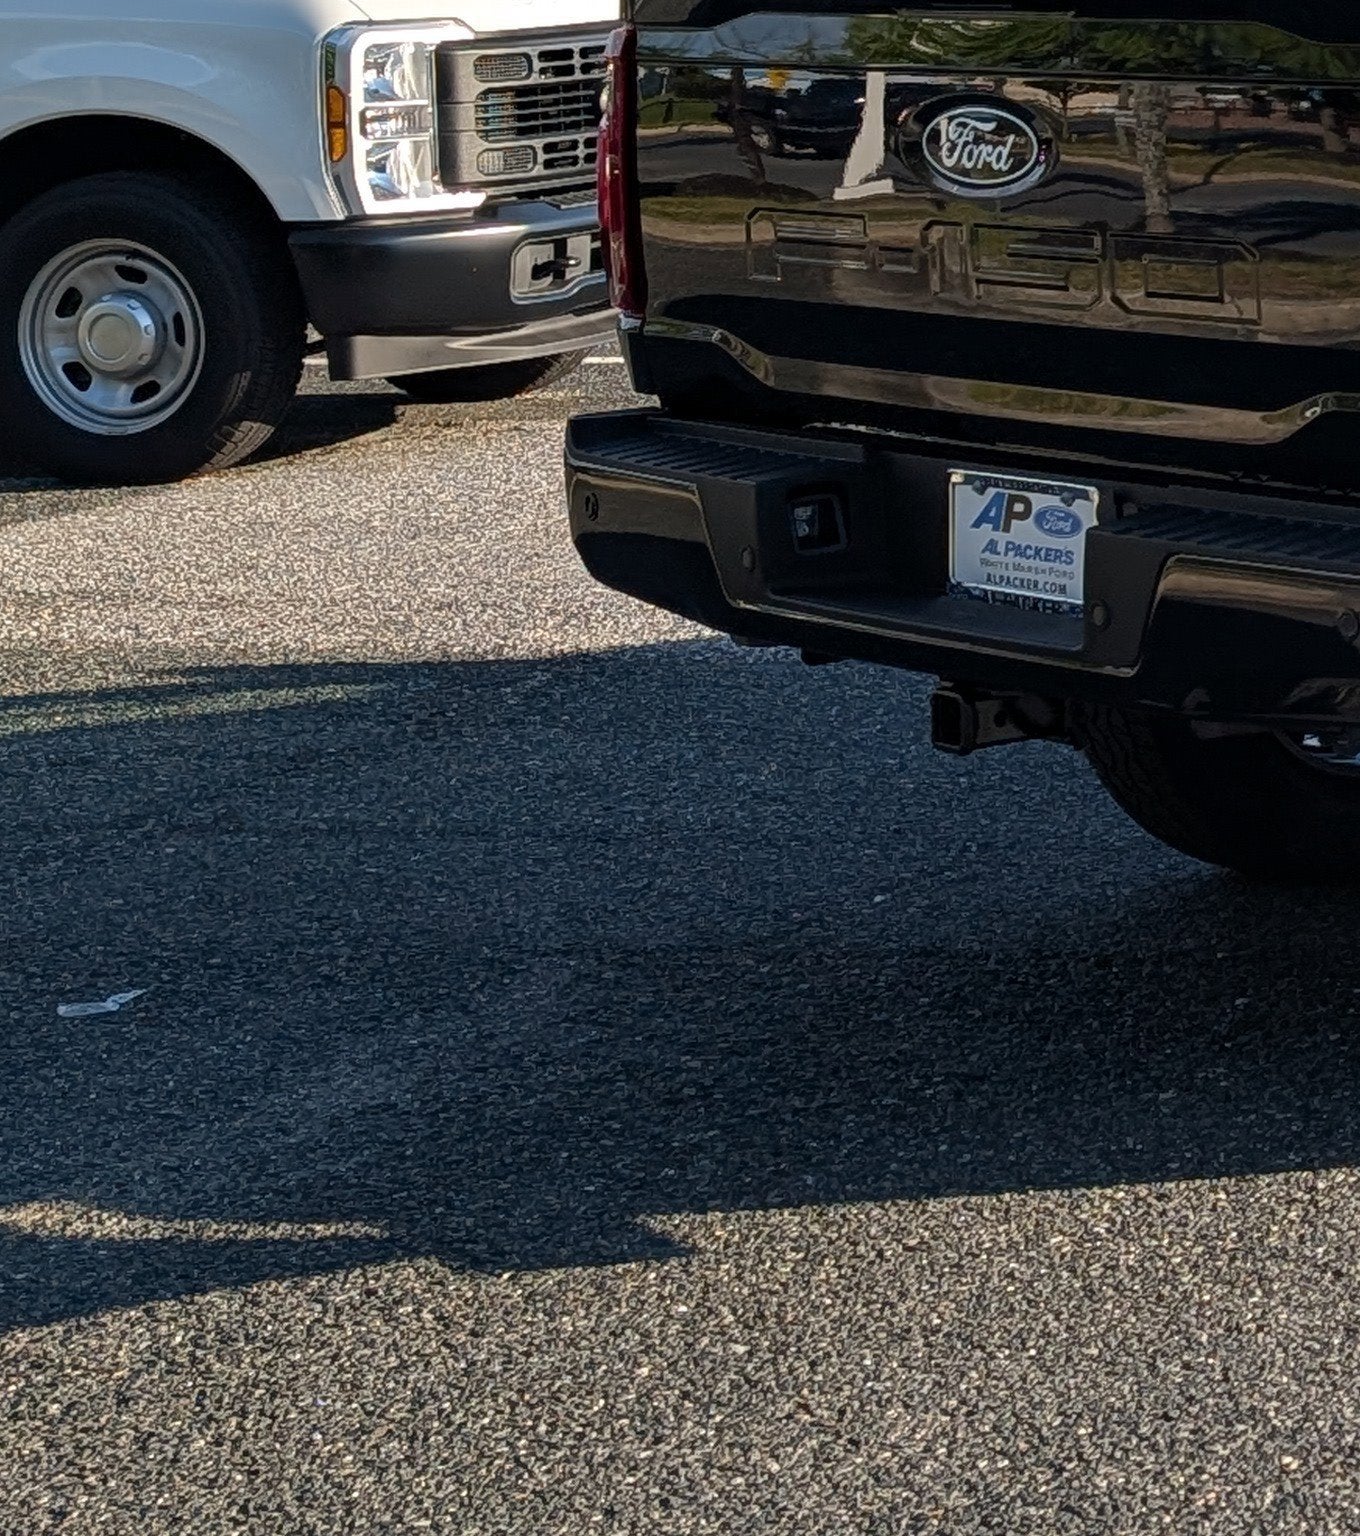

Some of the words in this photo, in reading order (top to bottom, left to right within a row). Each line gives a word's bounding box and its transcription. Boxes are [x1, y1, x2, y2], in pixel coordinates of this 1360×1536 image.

[940, 117, 1015, 171] Ford
[969, 490, 1033, 533] AP
[1041, 509, 1075, 533] Ford
[981, 538, 1001, 556] AL
[985, 572, 1068, 595] ALPACKER.COM
